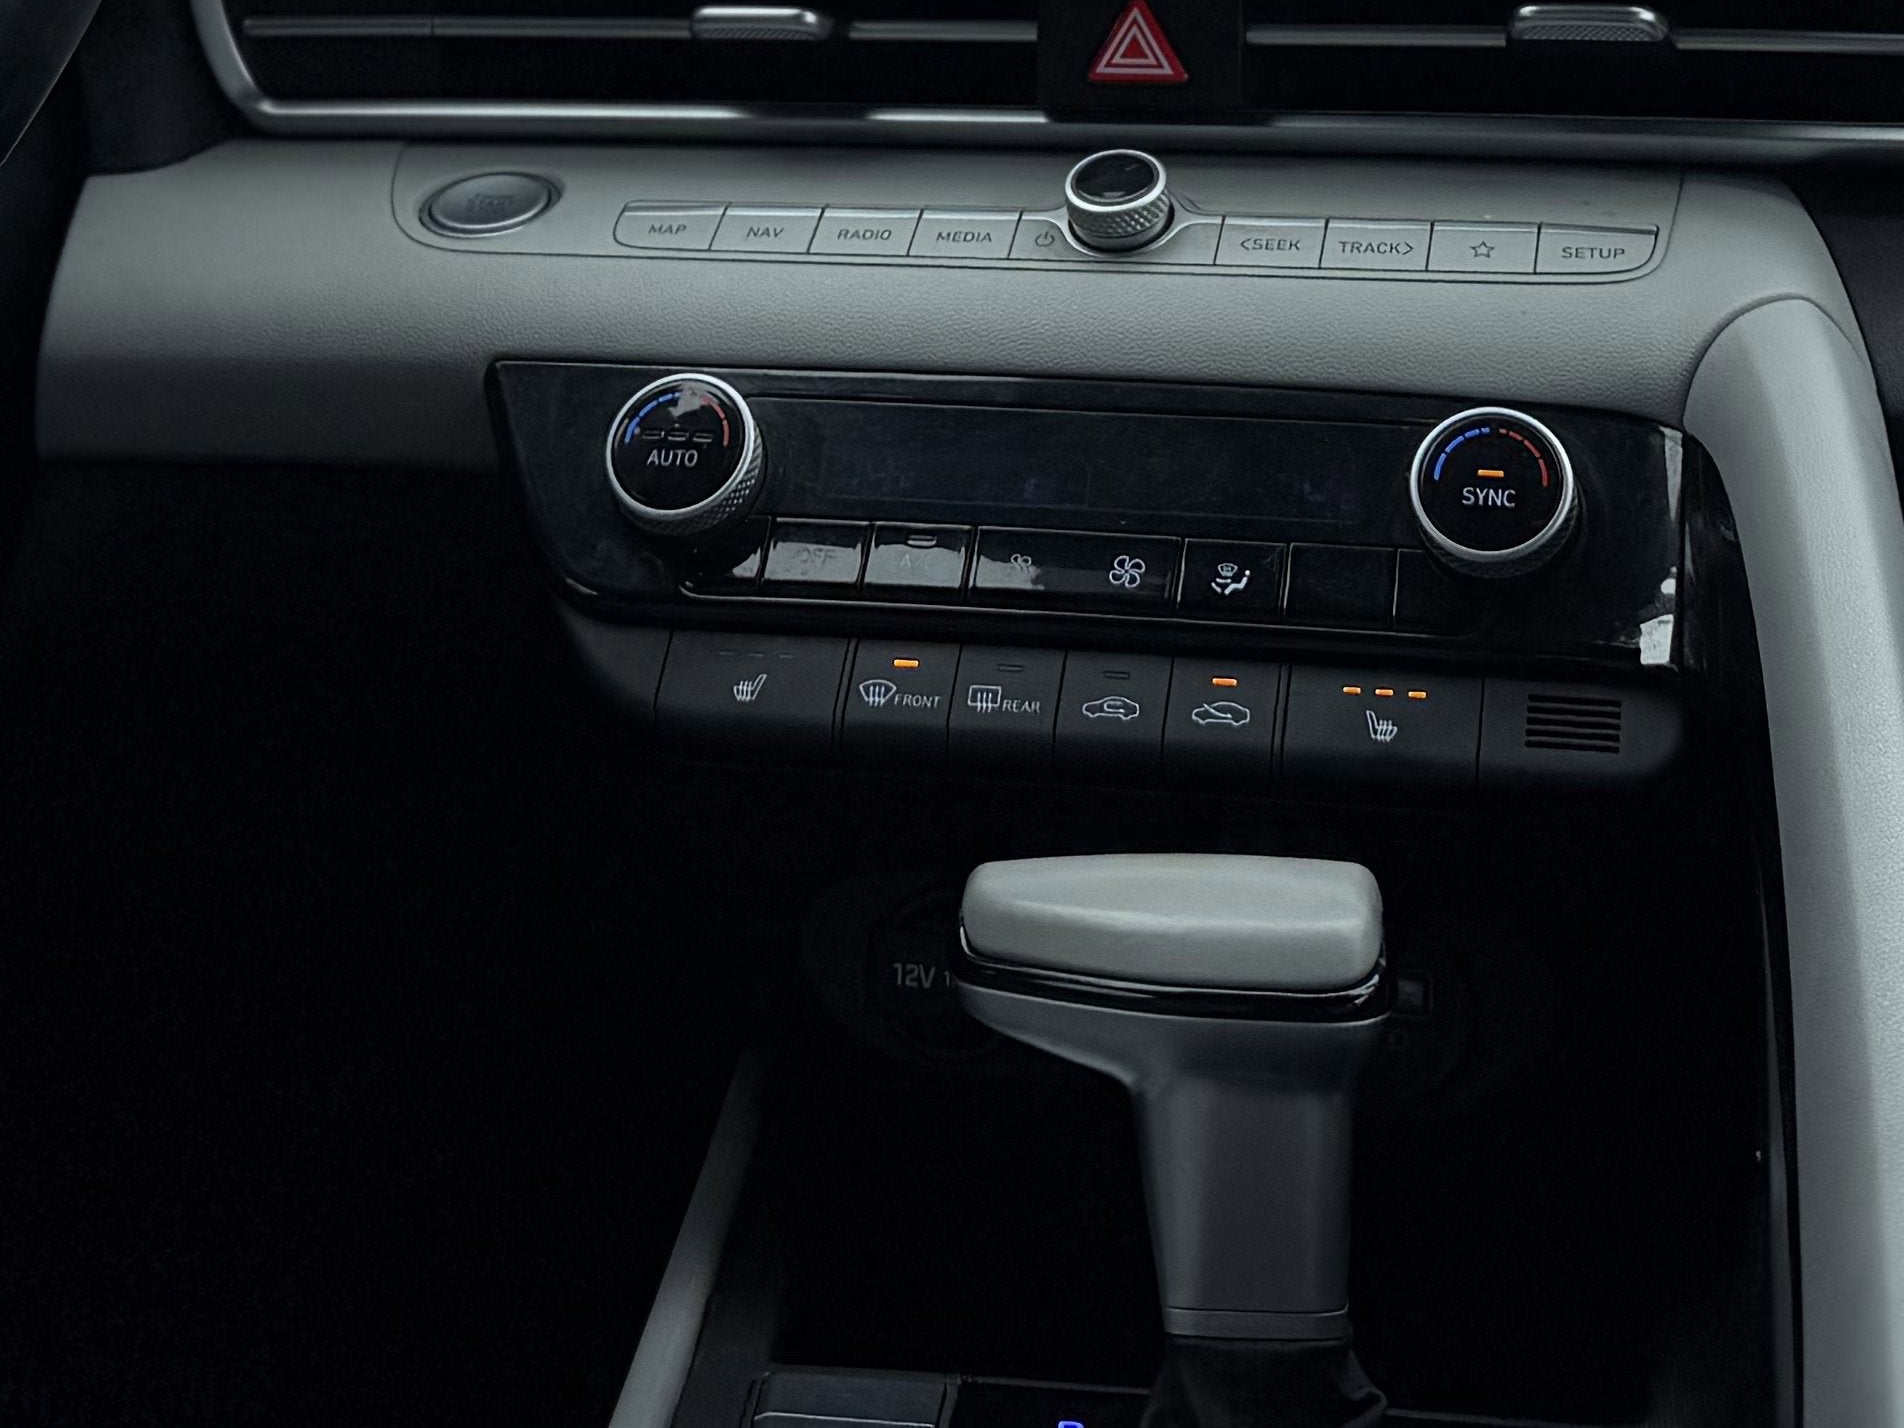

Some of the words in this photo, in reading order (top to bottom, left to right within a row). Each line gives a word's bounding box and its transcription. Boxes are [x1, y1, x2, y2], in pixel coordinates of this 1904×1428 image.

[648, 223, 687, 236] MAP
[746, 225, 785, 240] NAV
[836, 228, 893, 242] RADIO
[936, 231, 993, 243] MEDIA
[1562, 246, 1626, 260] SETUP
[646, 448, 699, 468] AUTO
[1461, 486, 1517, 508] SYNC
[894, 693, 942, 709] FRONT
[1001, 698, 1041, 713] REAR
[892, 962, 936, 989] 12V
